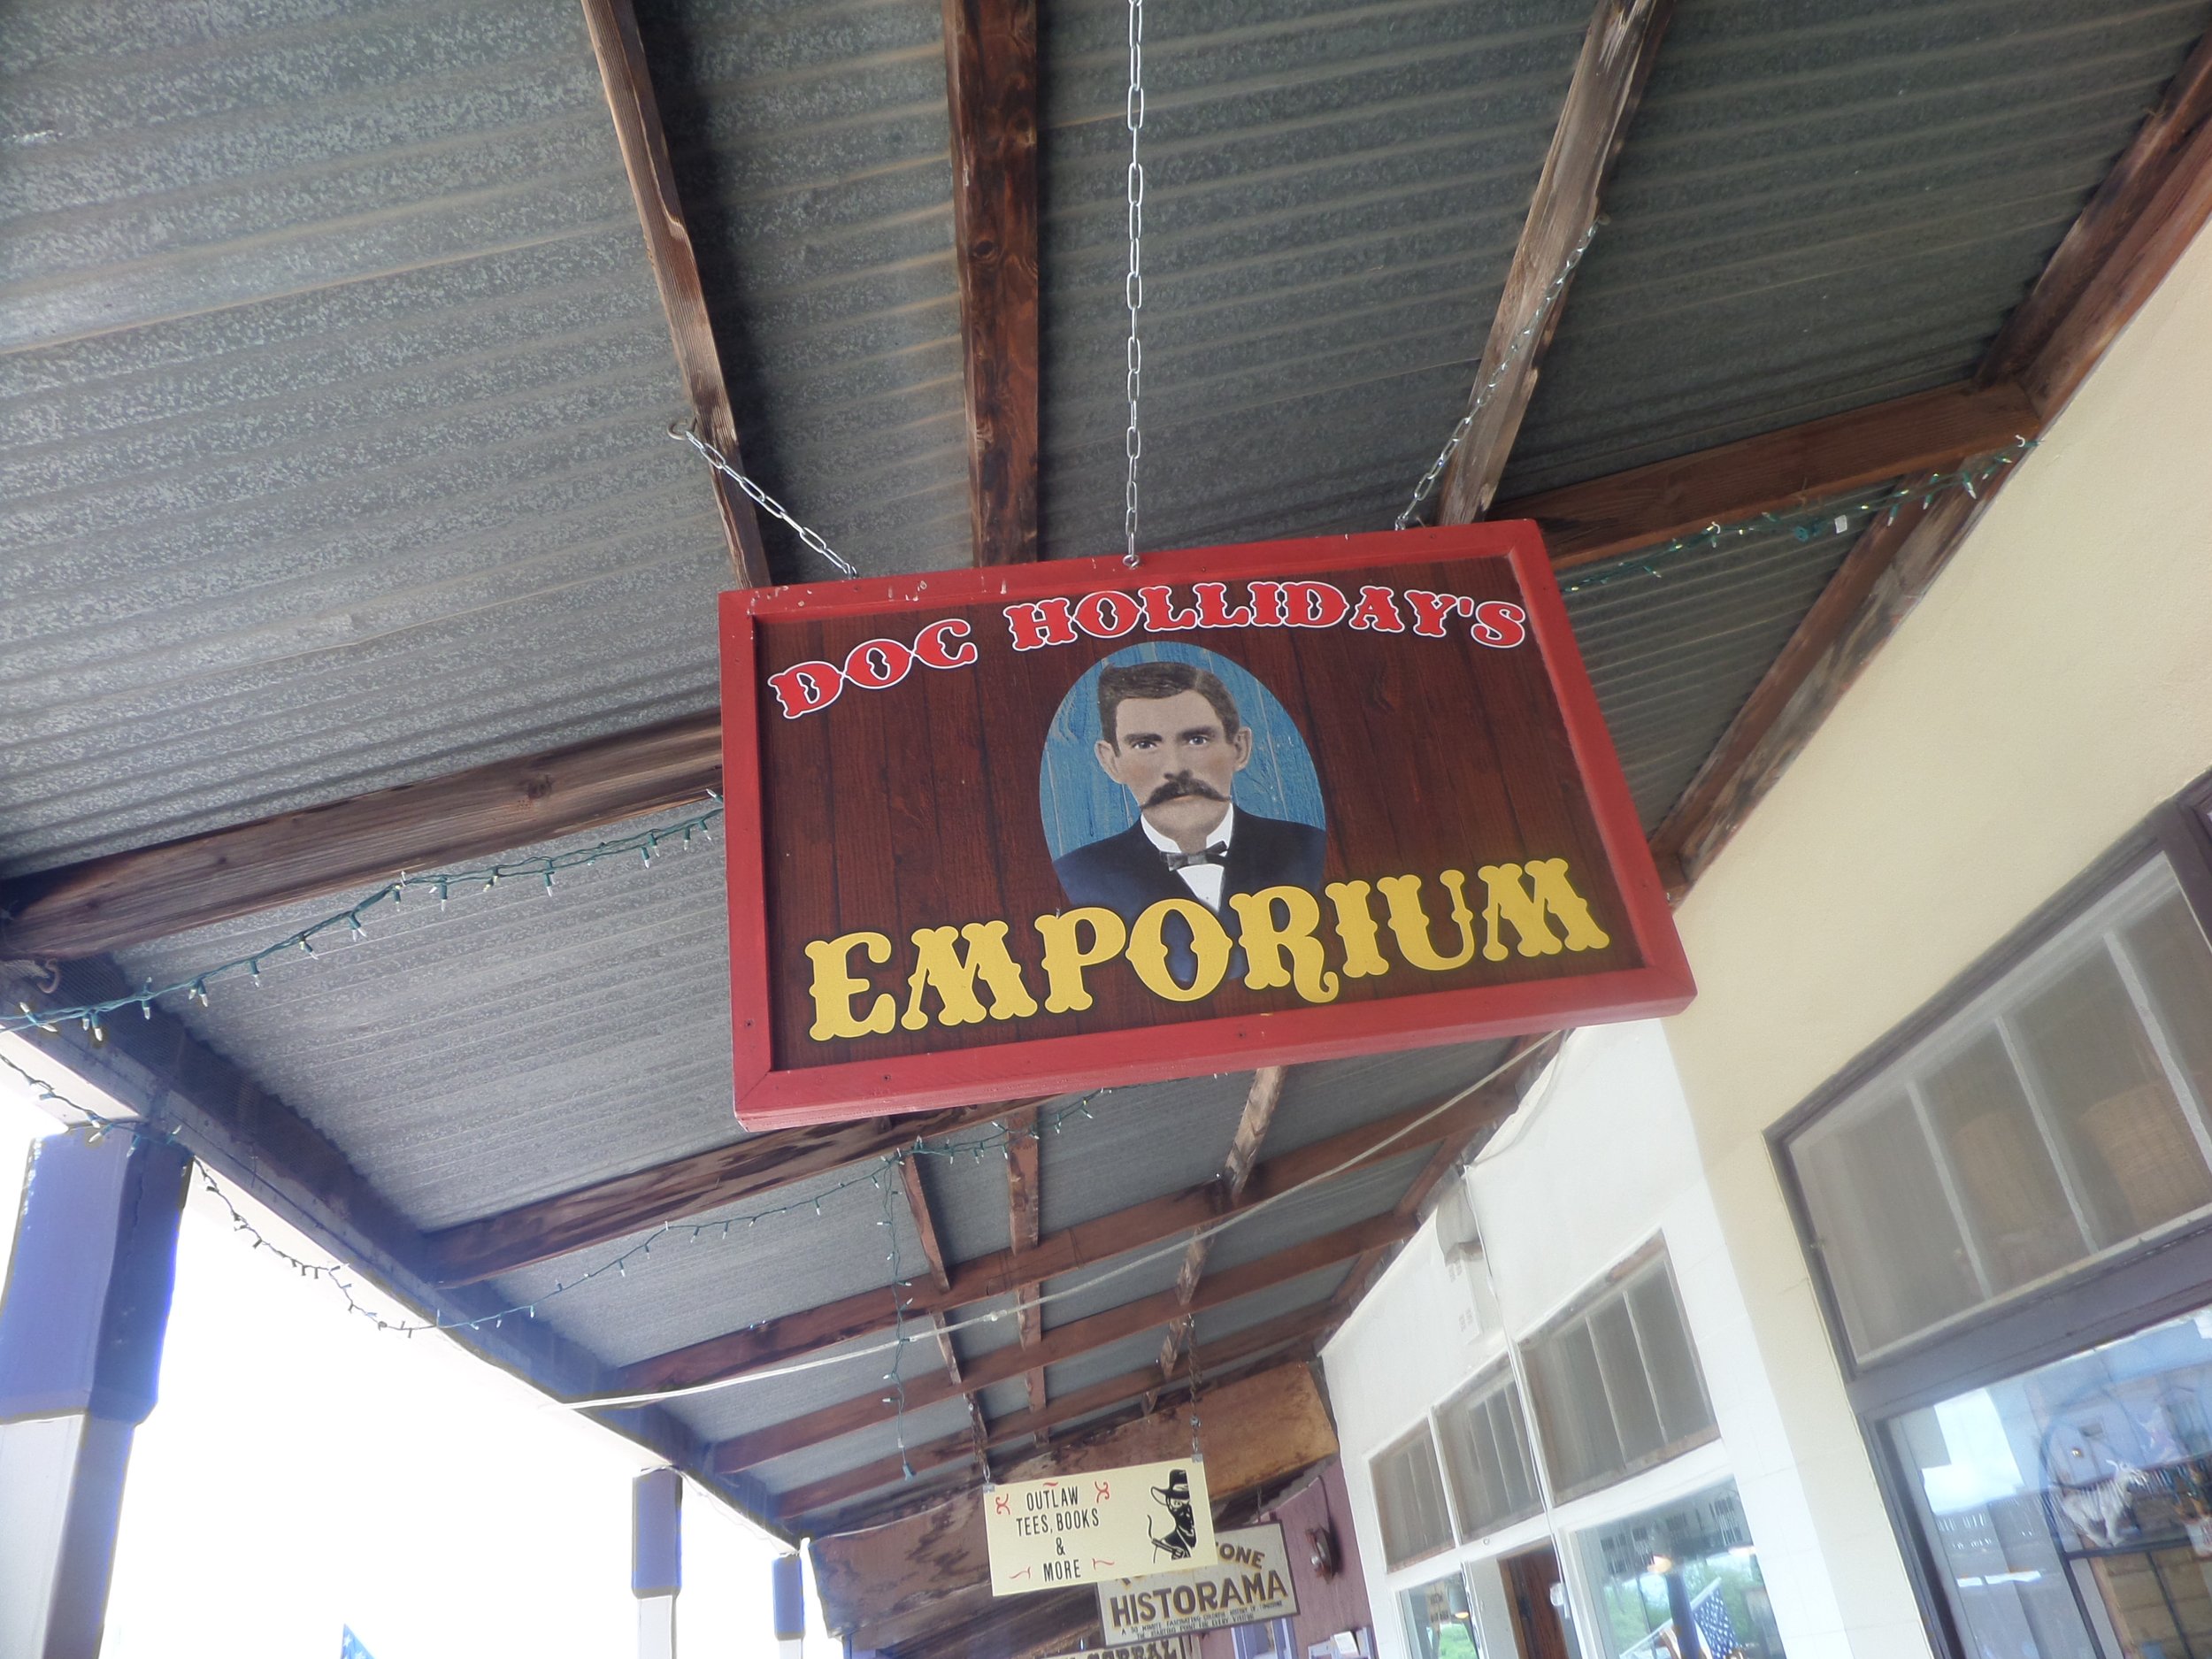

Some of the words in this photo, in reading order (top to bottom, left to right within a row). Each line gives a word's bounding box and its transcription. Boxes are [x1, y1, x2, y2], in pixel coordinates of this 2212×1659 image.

[767, 617, 978, 720] DOC
[1002, 580, 1529, 652] HOLLIDAY'S
[803, 858, 1611, 1043] EMPORIUM
[1026, 1486, 1079, 1511] OUTLAW
[1016, 1515, 1053, 1537] TEES,
[1056, 1508, 1100, 1532] BOOKS
[1056, 1537, 1066, 1555] &
[1043, 1559, 1081, 1582] MORE
[1110, 1570, 1289, 1628] HISTORAMA
